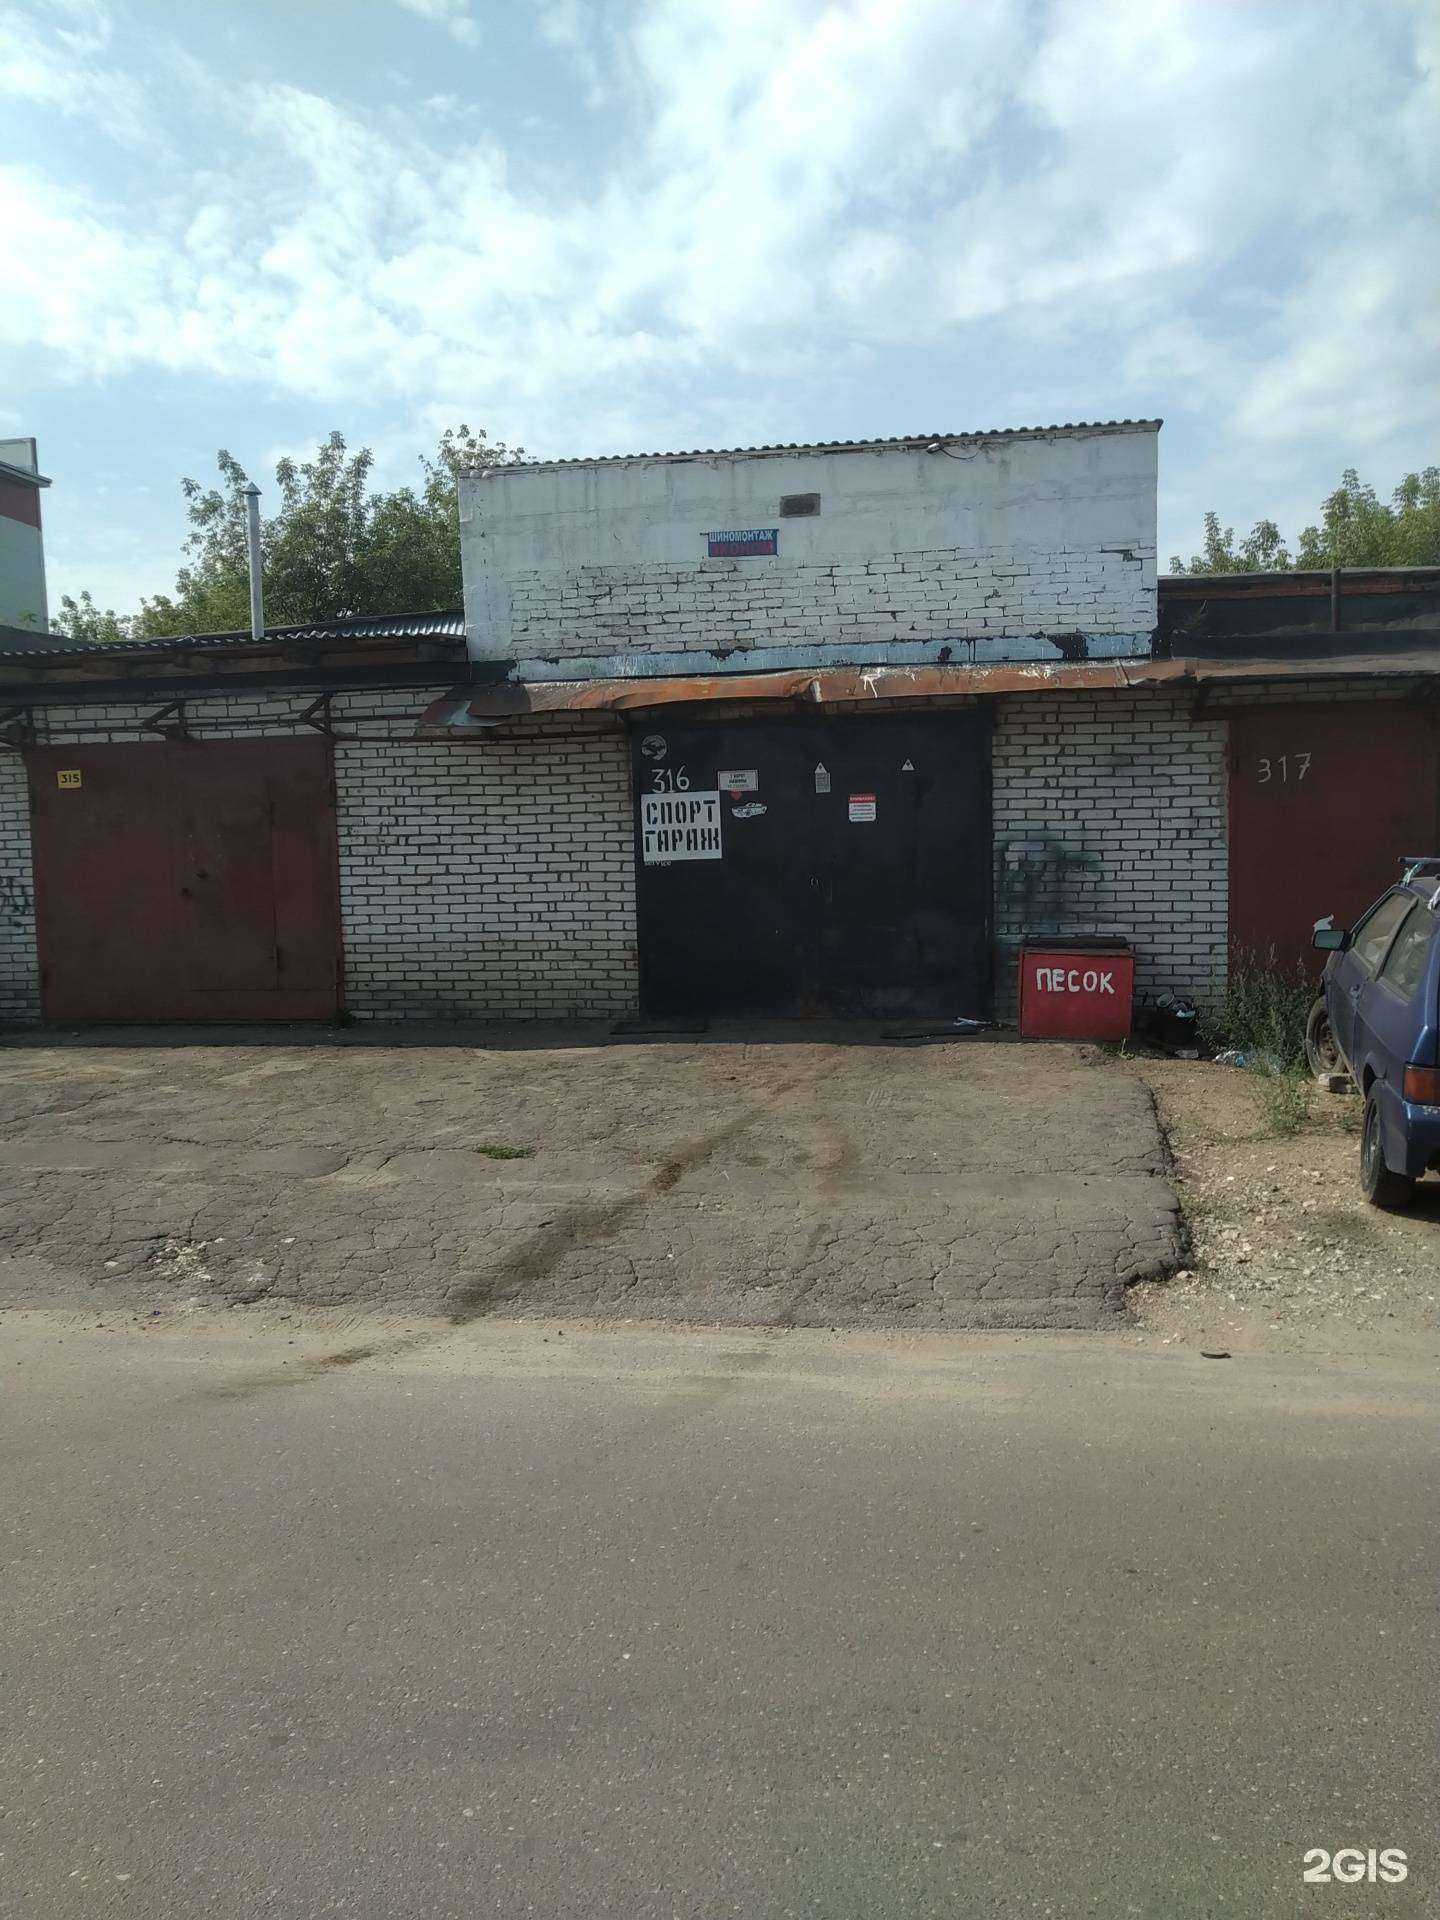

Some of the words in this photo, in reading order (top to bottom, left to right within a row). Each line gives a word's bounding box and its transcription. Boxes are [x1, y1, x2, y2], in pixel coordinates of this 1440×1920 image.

[709, 531, 772, 542] ШИНОМОНТАЖ
[61, 774, 80, 784] 315
[652, 765, 690, 793] 316
[1258, 752, 1312, 782] 317
[646, 800, 716, 825] СПОРТ
[645, 828, 719, 852] ГАРАЖ
[1037, 968, 1115, 994] ПЕСОК
